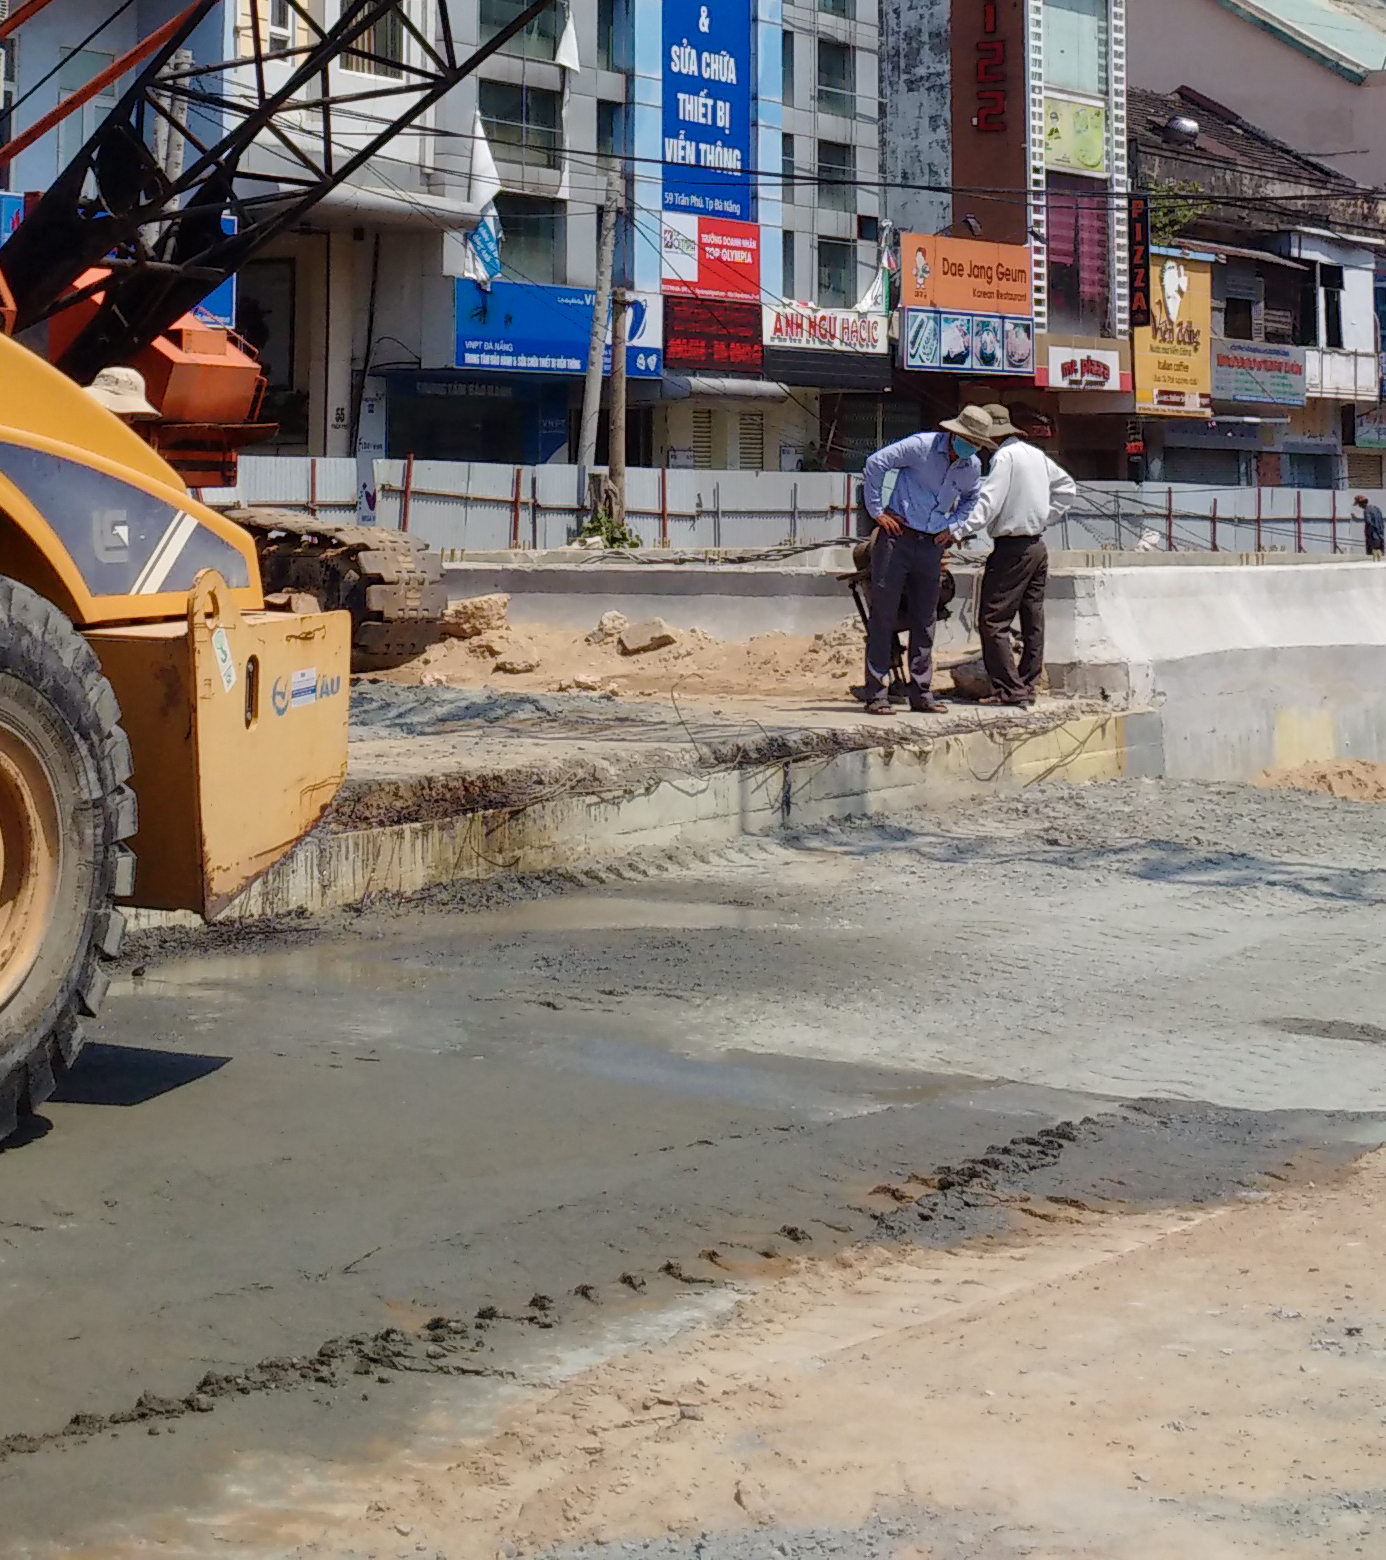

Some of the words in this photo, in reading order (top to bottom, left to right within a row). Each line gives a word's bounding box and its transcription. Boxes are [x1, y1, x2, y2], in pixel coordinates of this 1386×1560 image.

[698, 5, 710, 34] &
[670, 38, 698, 77] SỬA
[701, 50, 737, 85] CHỮA
[677, 88, 713, 126] THIẾT
[716, 100, 731, 135] BỊ
[664, 130, 696, 165] VIỄN
[698, 140, 742, 177] THÔNG
[664, 191, 673, 205] 59
[720, 248, 753, 264] OLYMPIA
[1131, 199, 1147, 311] PIZZA
[942, 257, 965, 278] Dae
[966, 260, 993, 285] Jang
[996, 263, 1027, 284] Geum
[972, 288, 995, 299] Korean
[996, 289, 1027, 302] Restaurant
[773, 312, 804, 339] ANH
[841, 317, 879, 344] HACIC
[464, 340, 483, 350] VNPT
[335, 407, 345, 423] 55
